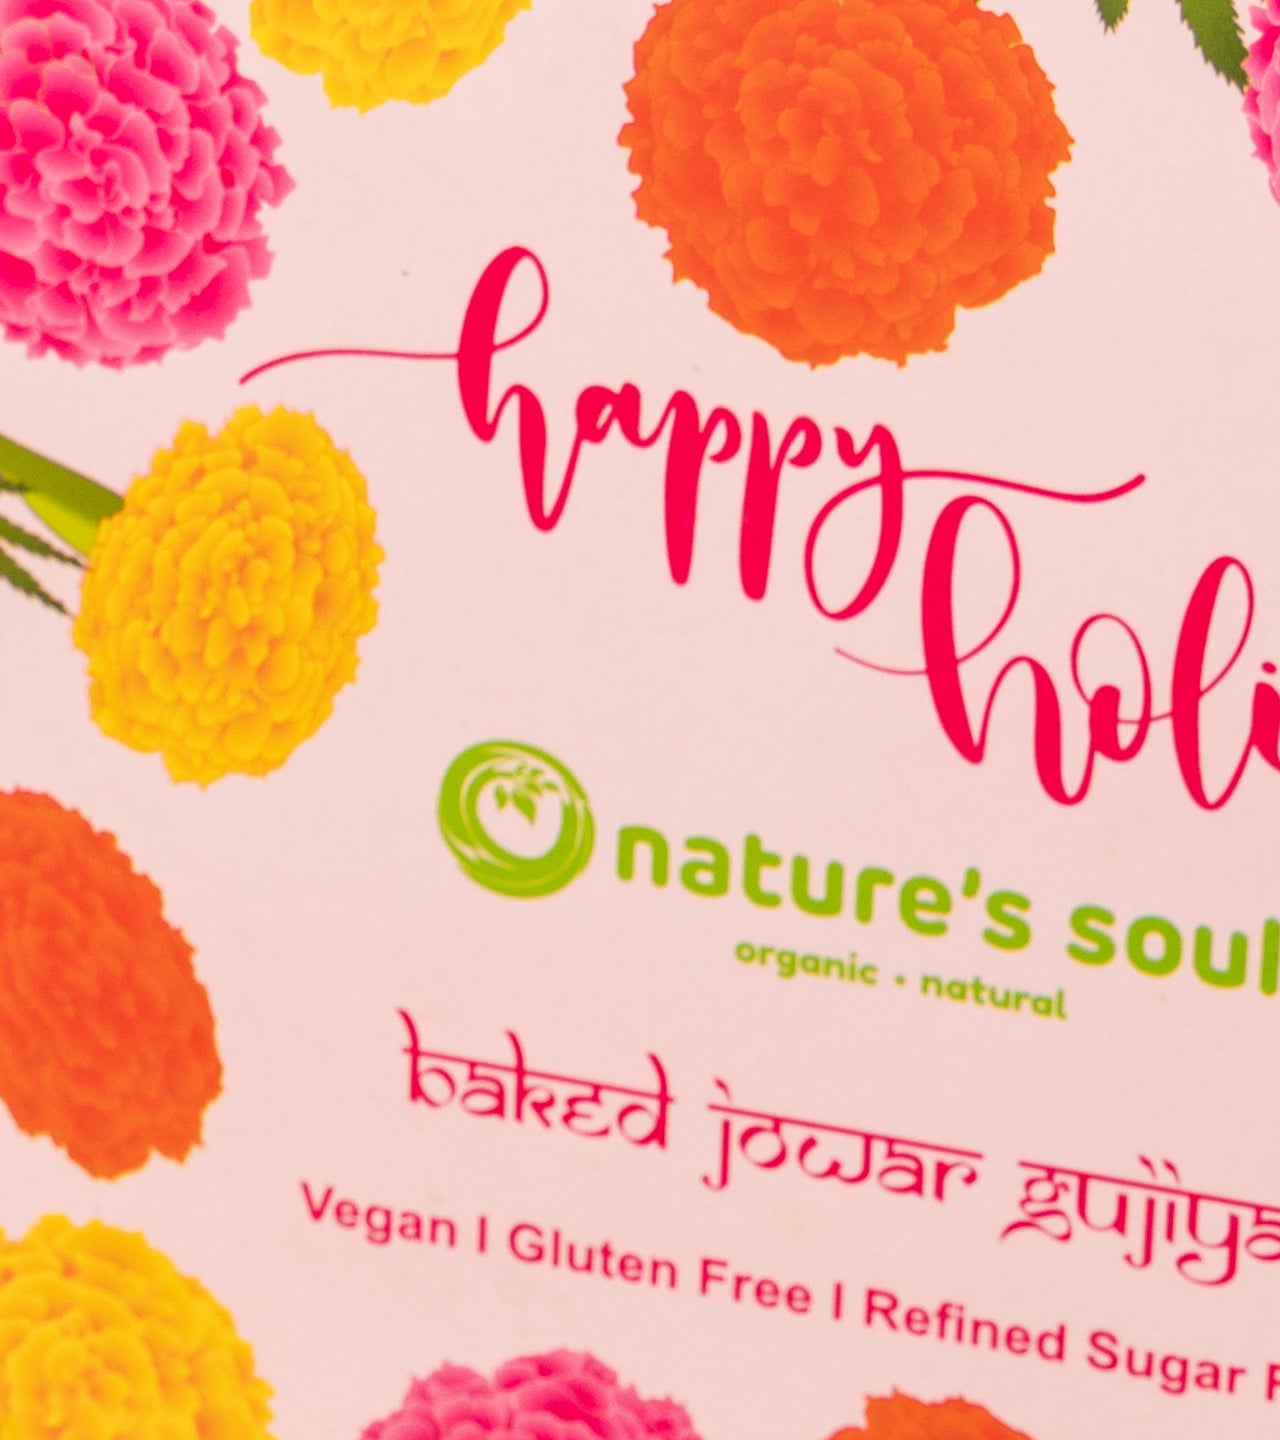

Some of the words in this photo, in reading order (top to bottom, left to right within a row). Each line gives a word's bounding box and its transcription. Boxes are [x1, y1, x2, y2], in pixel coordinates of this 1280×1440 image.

[239, 244, 1147, 622] happy
[617, 825, 1032, 954] nature's
[734, 936, 879, 989] organic
[920, 973, 1068, 1021] natural
[396, 1007, 675, 1150] baked
[702, 1077, 984, 1202] jowar
[300, 1181, 458, 1248] Vegan
[507, 1222, 679, 1290] Gluten
[698, 1257, 812, 1315] Free
[863, 1287, 1067, 1362] Refined
[1086, 1329, 1247, 1396] Sugar
